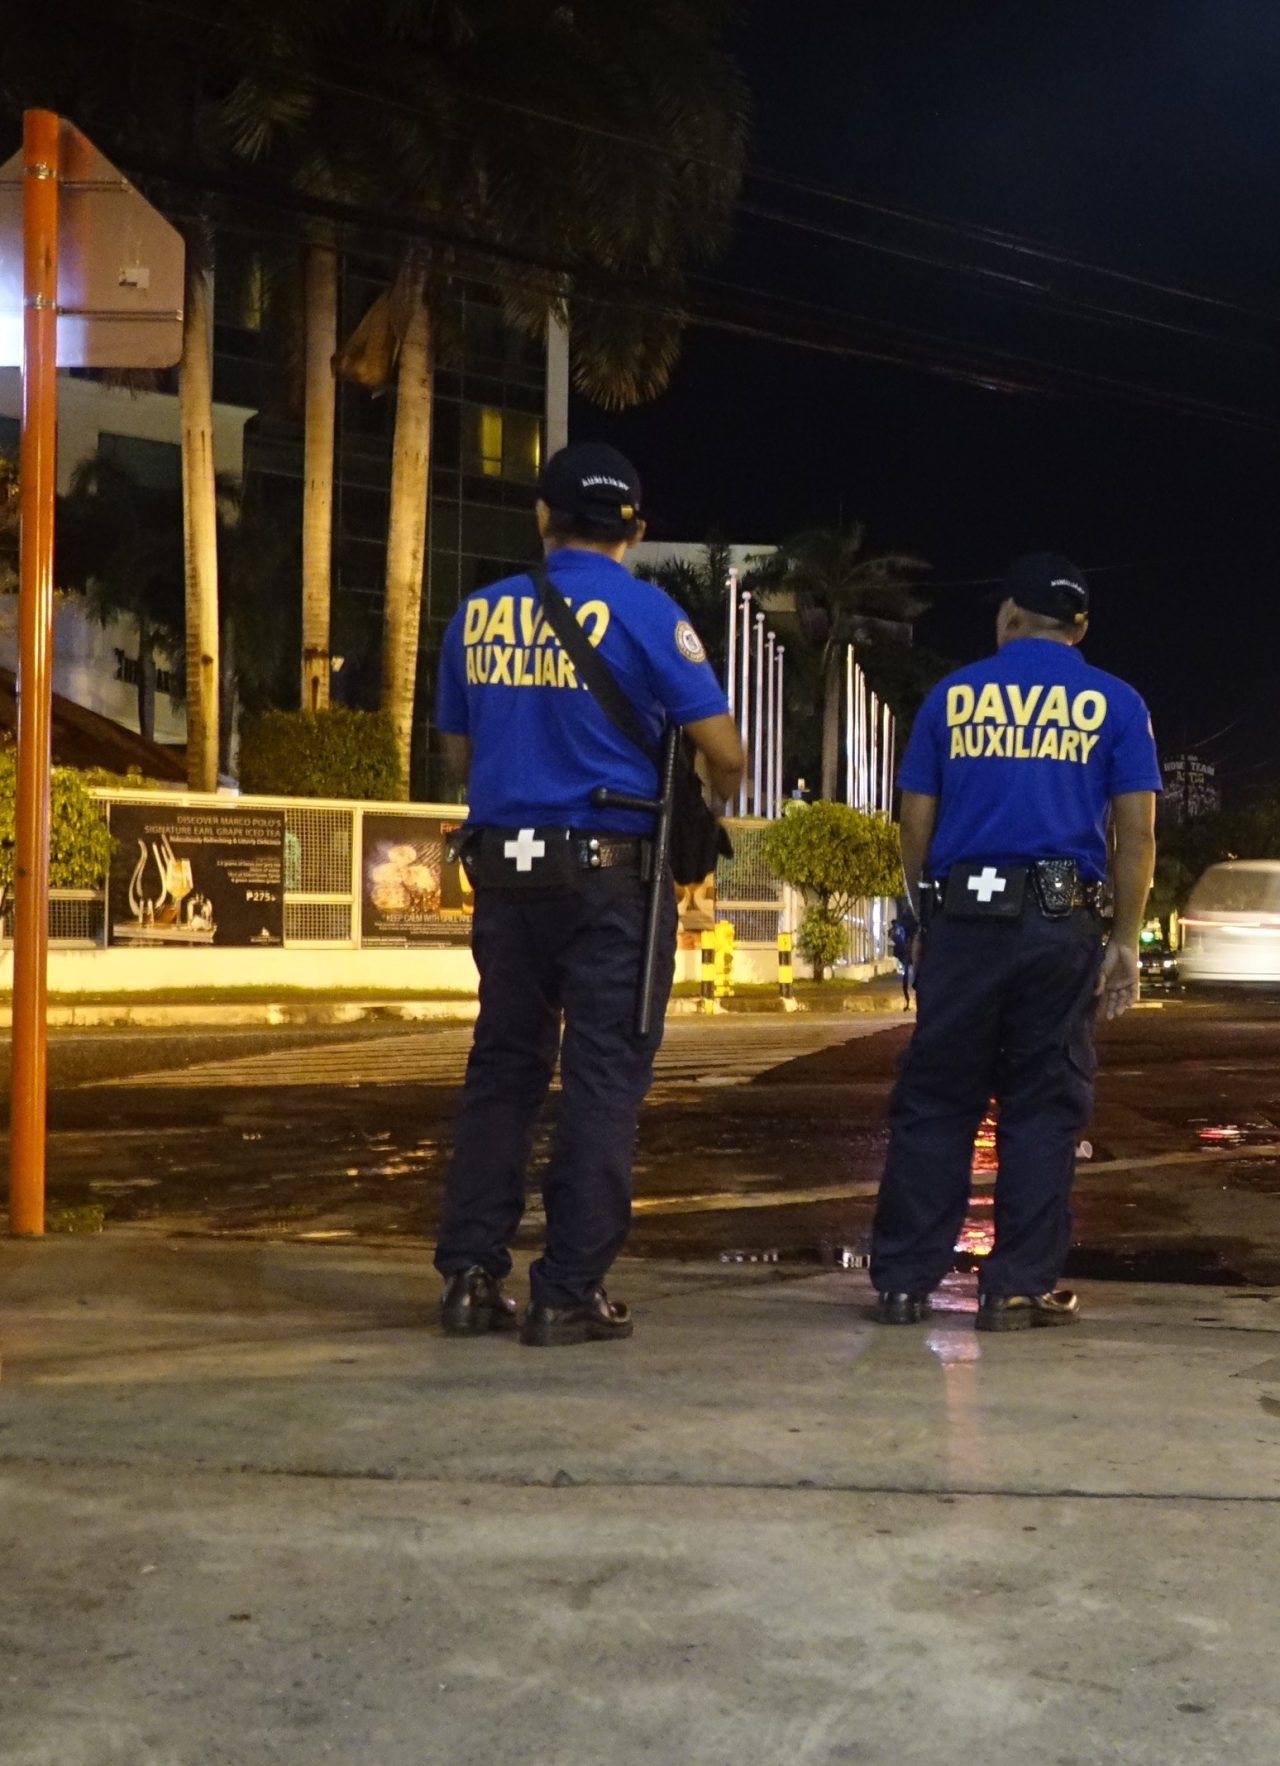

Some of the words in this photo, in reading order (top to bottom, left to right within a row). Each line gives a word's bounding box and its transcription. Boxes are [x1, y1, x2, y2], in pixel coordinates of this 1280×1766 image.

[466, 645, 589, 690] AUXILIAR
[946, 683, 1108, 732] DAVAO
[950, 724, 1100, 765] AUXILIARY
[144, 824, 191, 835] SIGNATURE
[193, 826, 214, 836] EARL
[245, 828, 264, 838] ICED
[266, 829, 281, 838] TEA
[177, 815, 219, 825] DISCOVER
[220, 817, 251, 826] MARCO
[252, 818, 281, 828] POLO'S
